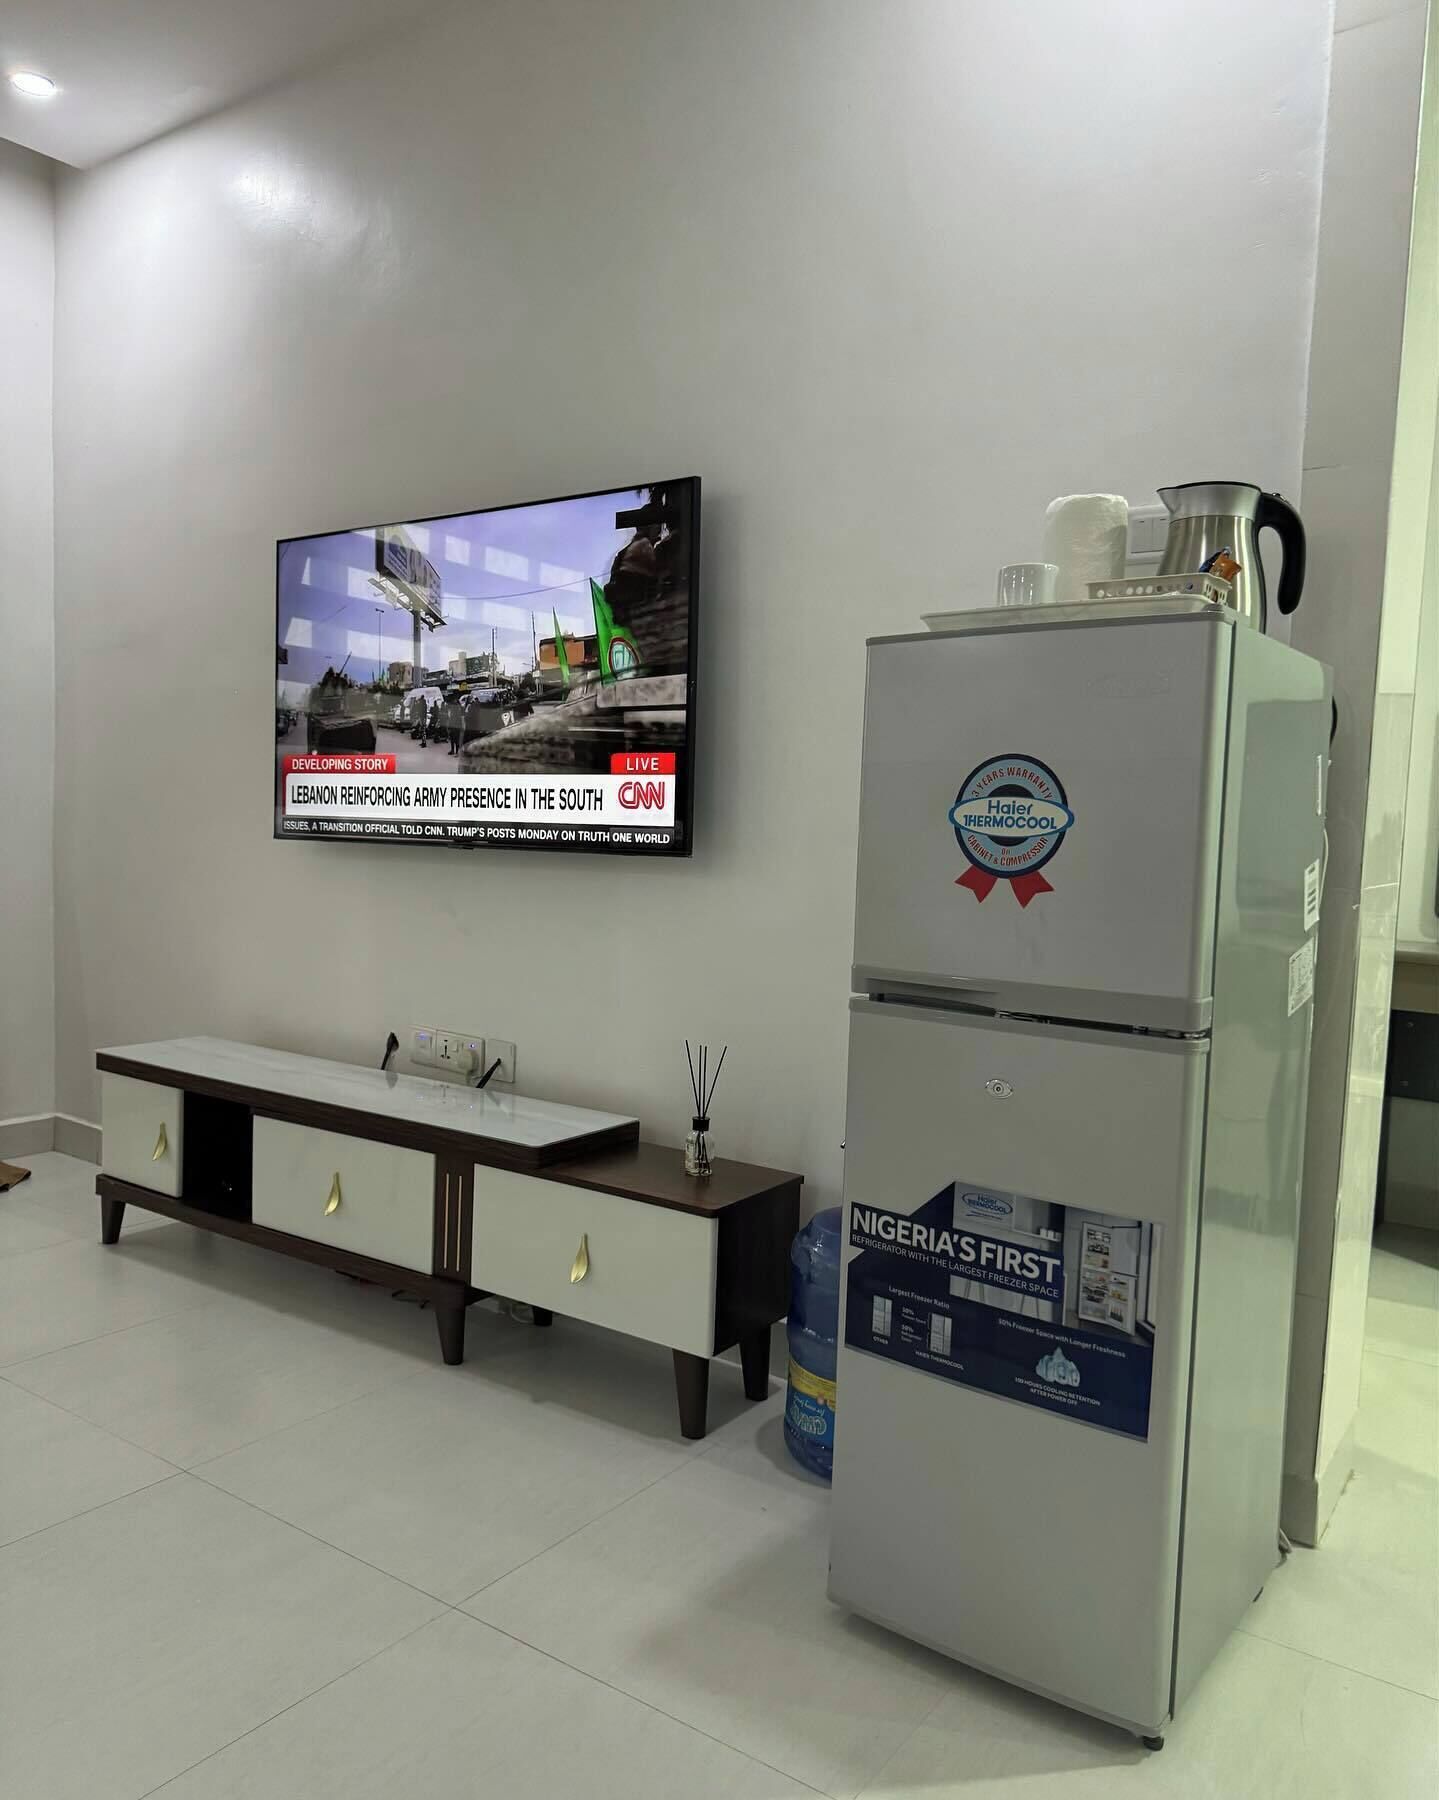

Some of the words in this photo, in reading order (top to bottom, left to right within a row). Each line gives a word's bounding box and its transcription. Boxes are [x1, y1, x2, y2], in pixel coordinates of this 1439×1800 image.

[292, 758, 352, 771] DEVELOPING
[354, 758, 389, 771] STORY
[626, 757, 660, 771] LIVE
[971, 789, 979, 797] 3
[976, 768, 1005, 790] YEARS
[1007, 766, 1053, 799] WARRANTY
[291, 785, 338, 805] LEBANON
[340, 785, 411, 807] REINFORCING
[413, 787, 447, 808] ARMY
[450, 787, 511, 809] PRESENCE
[515, 788, 527, 809] IN
[531, 788, 555, 810] THE
[559, 788, 603, 811] SOUTH
[618, 781, 665, 810] CNN
[988, 799, 1033, 815] Haier
[284, 820, 311, 832] ISSUES,
[312, 821, 318, 831] A
[319, 821, 363, 833] TRANSITION
[365, 823, 400, 835] OFFICIAL
[401, 824, 423, 835] TOLD
[424, 825, 445, 836] CNN.
[447, 826, 485, 838] TRUMP'S
[487, 827, 516, 839] POSTS
[518, 829, 558, 841] MONDAY
[561, 830, 575, 841] ON
[578, 831, 610, 842] TRUTH
[963, 814, 1057, 829] THERMOCOOL
[612, 832, 632, 843] ONE
[634, 833, 670, 844] WORLD
[967, 834, 993, 862] CABINET
[1000, 836, 1049, 867] COMPRESSOR
[852, 1207, 976, 1263] NIGERIA'S
[980, 1240, 1061, 1283] FIRST
[852, 1234, 908, 1258] REFRIGERATOR
[907, 1249, 930, 1264] WITH
[930, 1255, 947, 1269] THE
[949, 1261, 987, 1280] LARGEST
[988, 1272, 1027, 1292] FREEZER
[1028, 1282, 1060, 1298] SPACE
[889, 1285, 911, 1298] Largest
[911, 1291, 933, 1305] Freezer
[933, 1298, 950, 1310] Ratio
[1036, 1328, 1054, 1340] Space
[1055, 1333, 1069, 1344] with
[1069, 1337, 1092, 1350] Longer
[1093, 1343, 1126, 1359] Freshness
[1030, 1387, 1047, 1398] AFTER
[1047, 1392, 1067, 1404] POWER
[1043, 1384, 1068, 1398] COOLING
[1068, 1390, 1101, 1406] RETENTION
